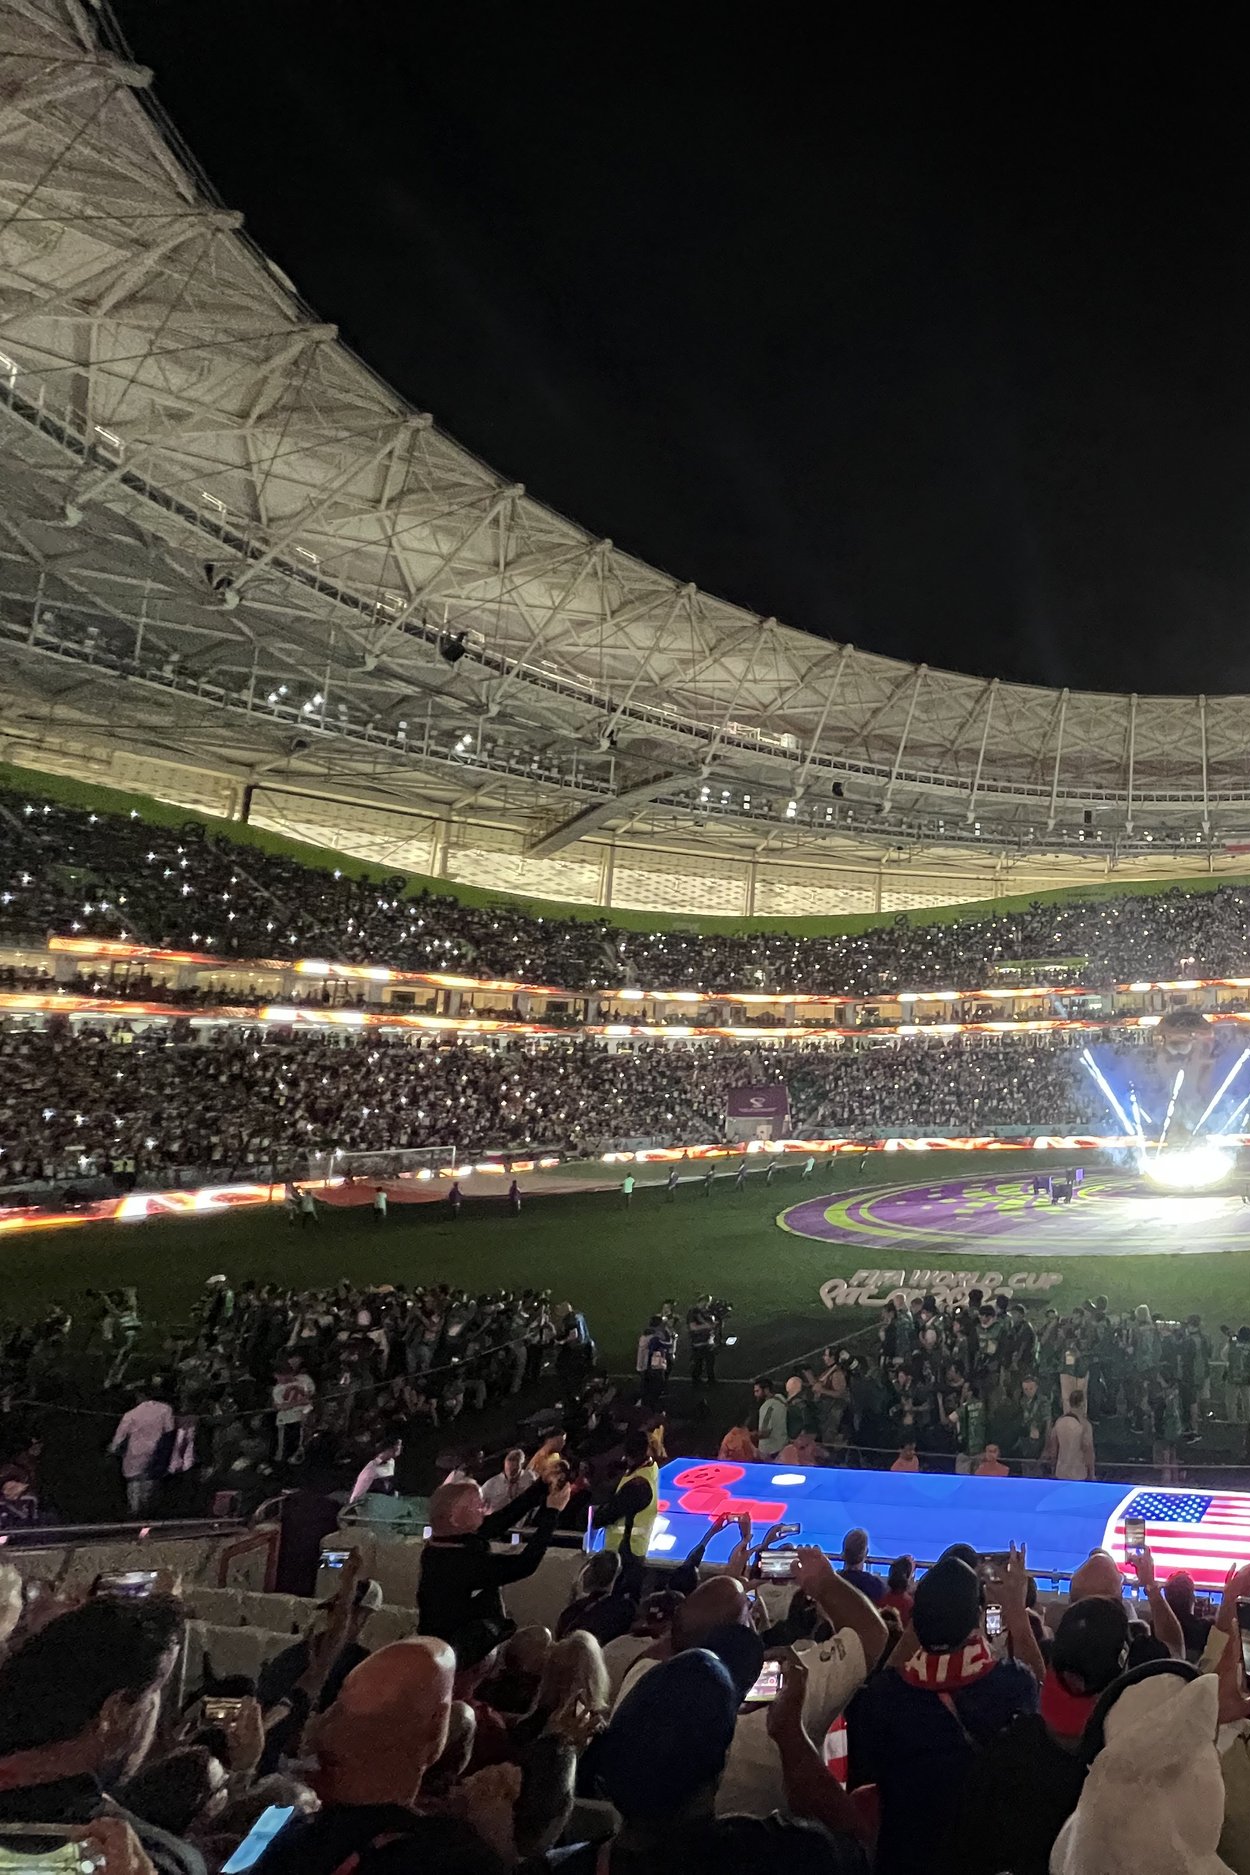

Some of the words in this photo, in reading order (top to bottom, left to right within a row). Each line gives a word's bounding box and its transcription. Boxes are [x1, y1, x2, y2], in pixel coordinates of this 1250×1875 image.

[849, 1269, 905, 1286] FIFA
[909, 1269, 1003, 1288] WORLD
[1008, 1272, 1064, 1290] CUP
